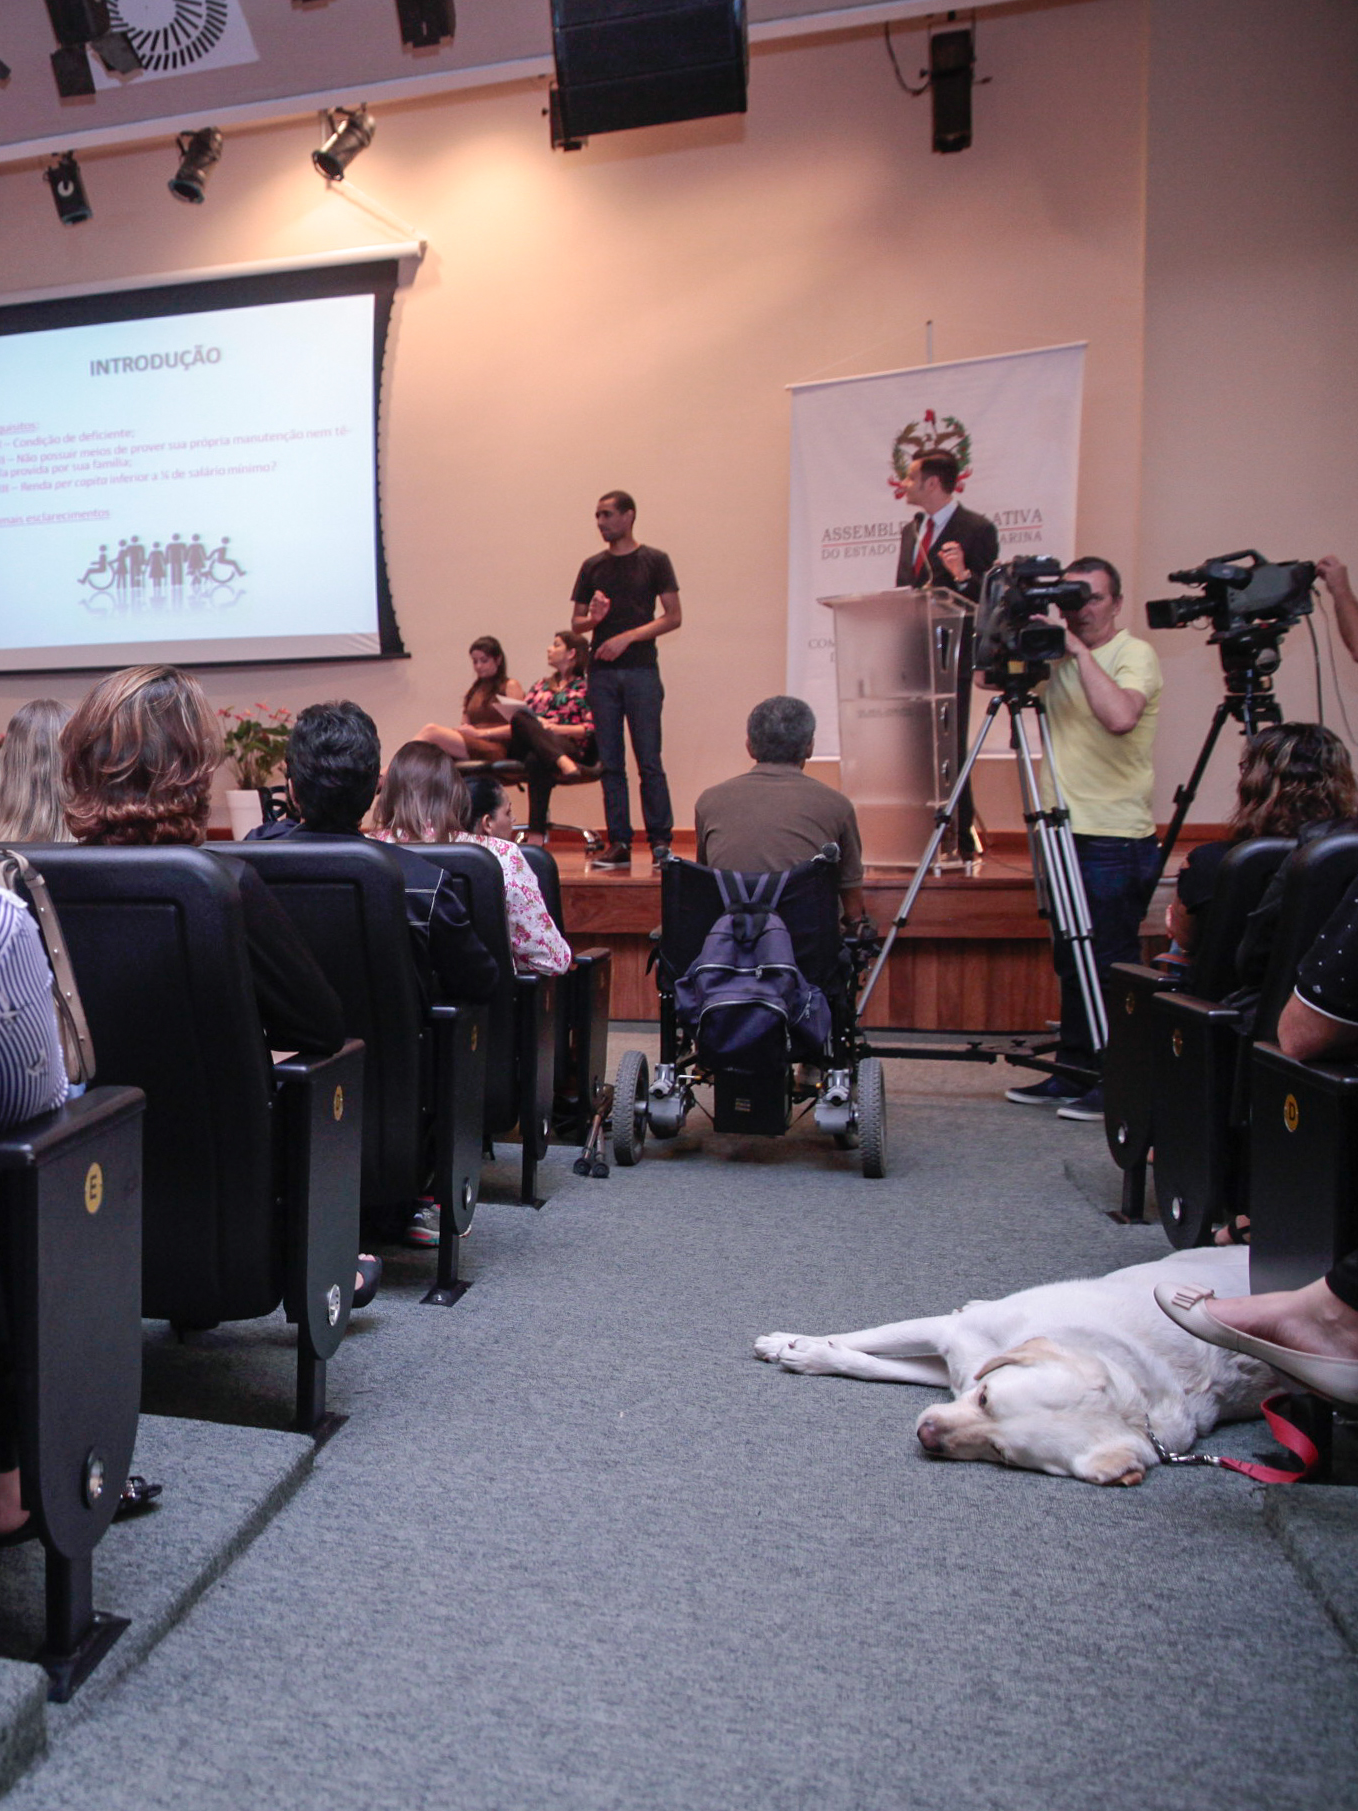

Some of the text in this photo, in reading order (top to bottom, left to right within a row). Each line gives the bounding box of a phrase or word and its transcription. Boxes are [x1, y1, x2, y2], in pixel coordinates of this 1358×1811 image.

[90, 345, 222, 377] INTRODUÇÃO
[12, 435, 61, 448] Condição
[62, 432, 77, 443] de
[16, 452, 38, 464] Não
[40, 448, 77, 463] possuir
[79, 446, 112, 458] meios
[114, 444, 128, 455] de
[130, 441, 165, 455] prover
[168, 440, 187, 450] sua
[190, 436, 230, 450] própria
[233, 428, 304, 445] manutenção
[306, 427, 332, 438] nem
[0, 468, 8, 478] la
[10, 464, 50, 479] provida
[51, 464, 69, 475] por
[72, 462, 90, 471] sua
[20, 479, 52, 492] Renda
[54, 478, 73, 491] per
[74, 474, 109, 488] capita
[109, 470, 149, 485] inferior
[171, 468, 185, 479] de
[188, 464, 226, 478] salário
[228, 460, 278, 475] mínimo?
[26, 508, 111, 525] esclarecimentos
[821, 543, 897, 560] DO ESTADO
[1289, 1102, 1297, 1120] D
[90, 1174, 98, 1199] E
